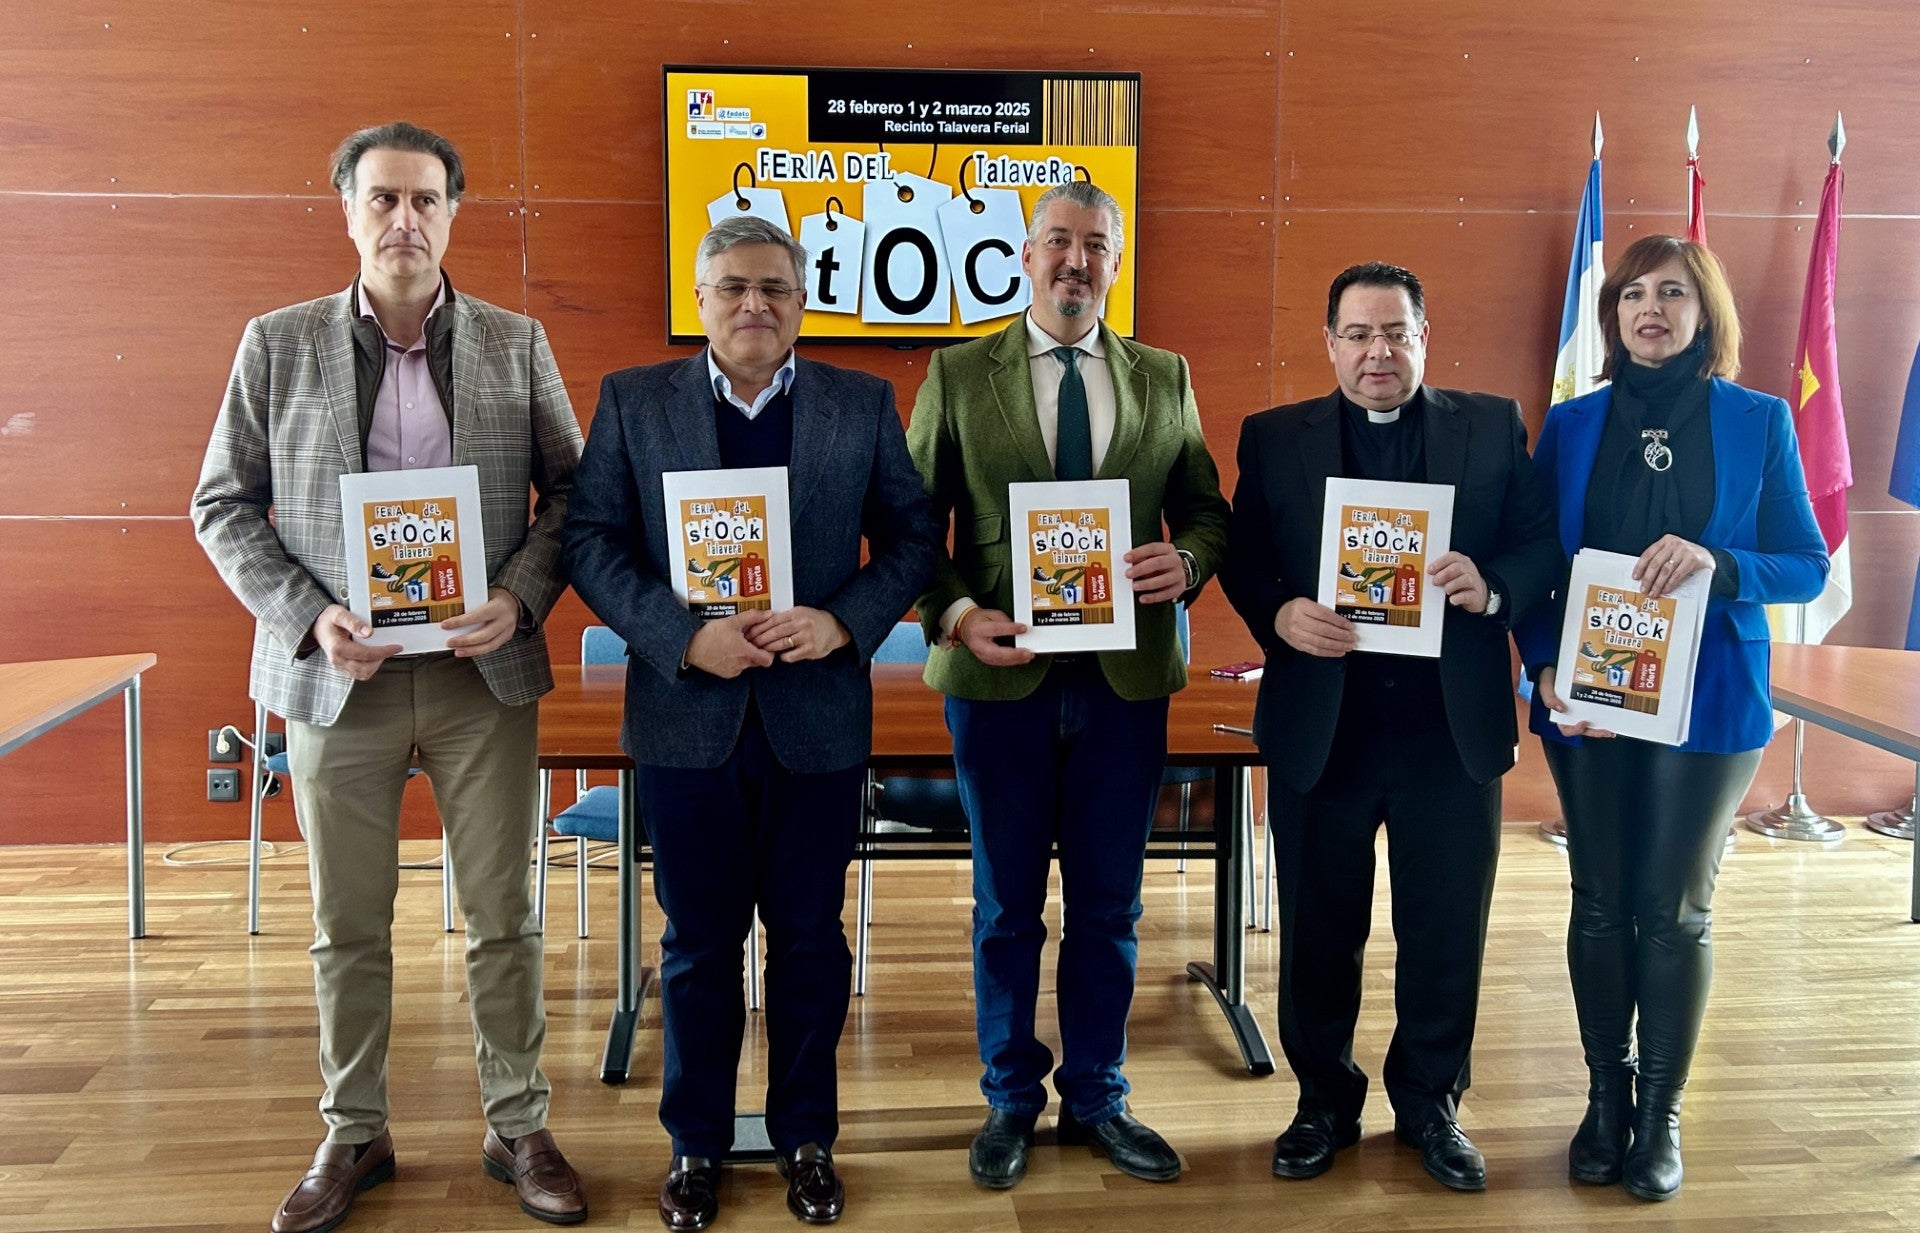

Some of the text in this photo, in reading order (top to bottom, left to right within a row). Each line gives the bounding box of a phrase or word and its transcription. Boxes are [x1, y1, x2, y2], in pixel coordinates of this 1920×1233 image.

[827, 100, 1030, 118] 28 febrero 1 y 2 marzo 2025
[884, 120, 1030, 134] Recinto Talavera Ferial
[760, 151, 894, 180] FERIA DEL
